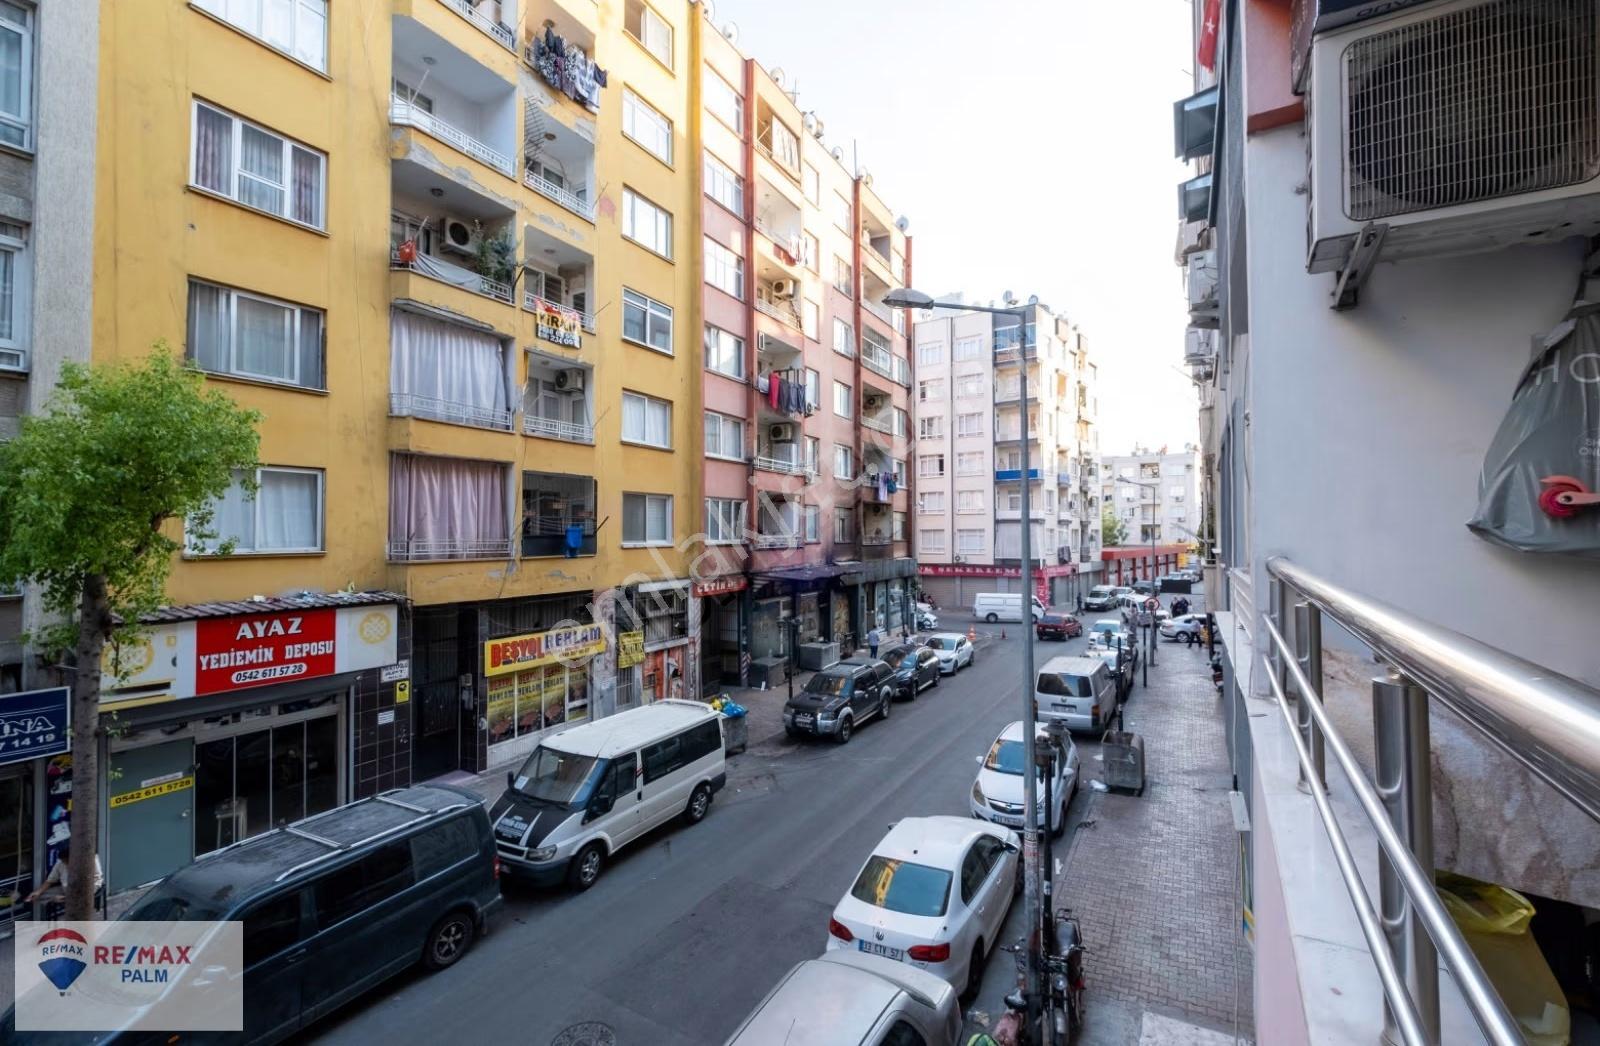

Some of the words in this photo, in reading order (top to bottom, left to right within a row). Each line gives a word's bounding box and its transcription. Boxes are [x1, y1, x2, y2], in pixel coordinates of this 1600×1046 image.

[236, 617, 302, 640] AYAZ
[200, 644, 274, 671] YEDİEMİN
[284, 640, 334, 660] DEPOSU
[236, 670, 260, 682] 0542
[261, 667, 277, 678] 611
[280, 666, 290, 676] 57
[292, 664, 304, 674] 28
[12, 738, 31, 748] 14
[36, 733, 56, 744] 19
[115, 792, 142, 804] 0542
[144, 786, 163, 796] 611
[166, 780, 191, 791] 5728
